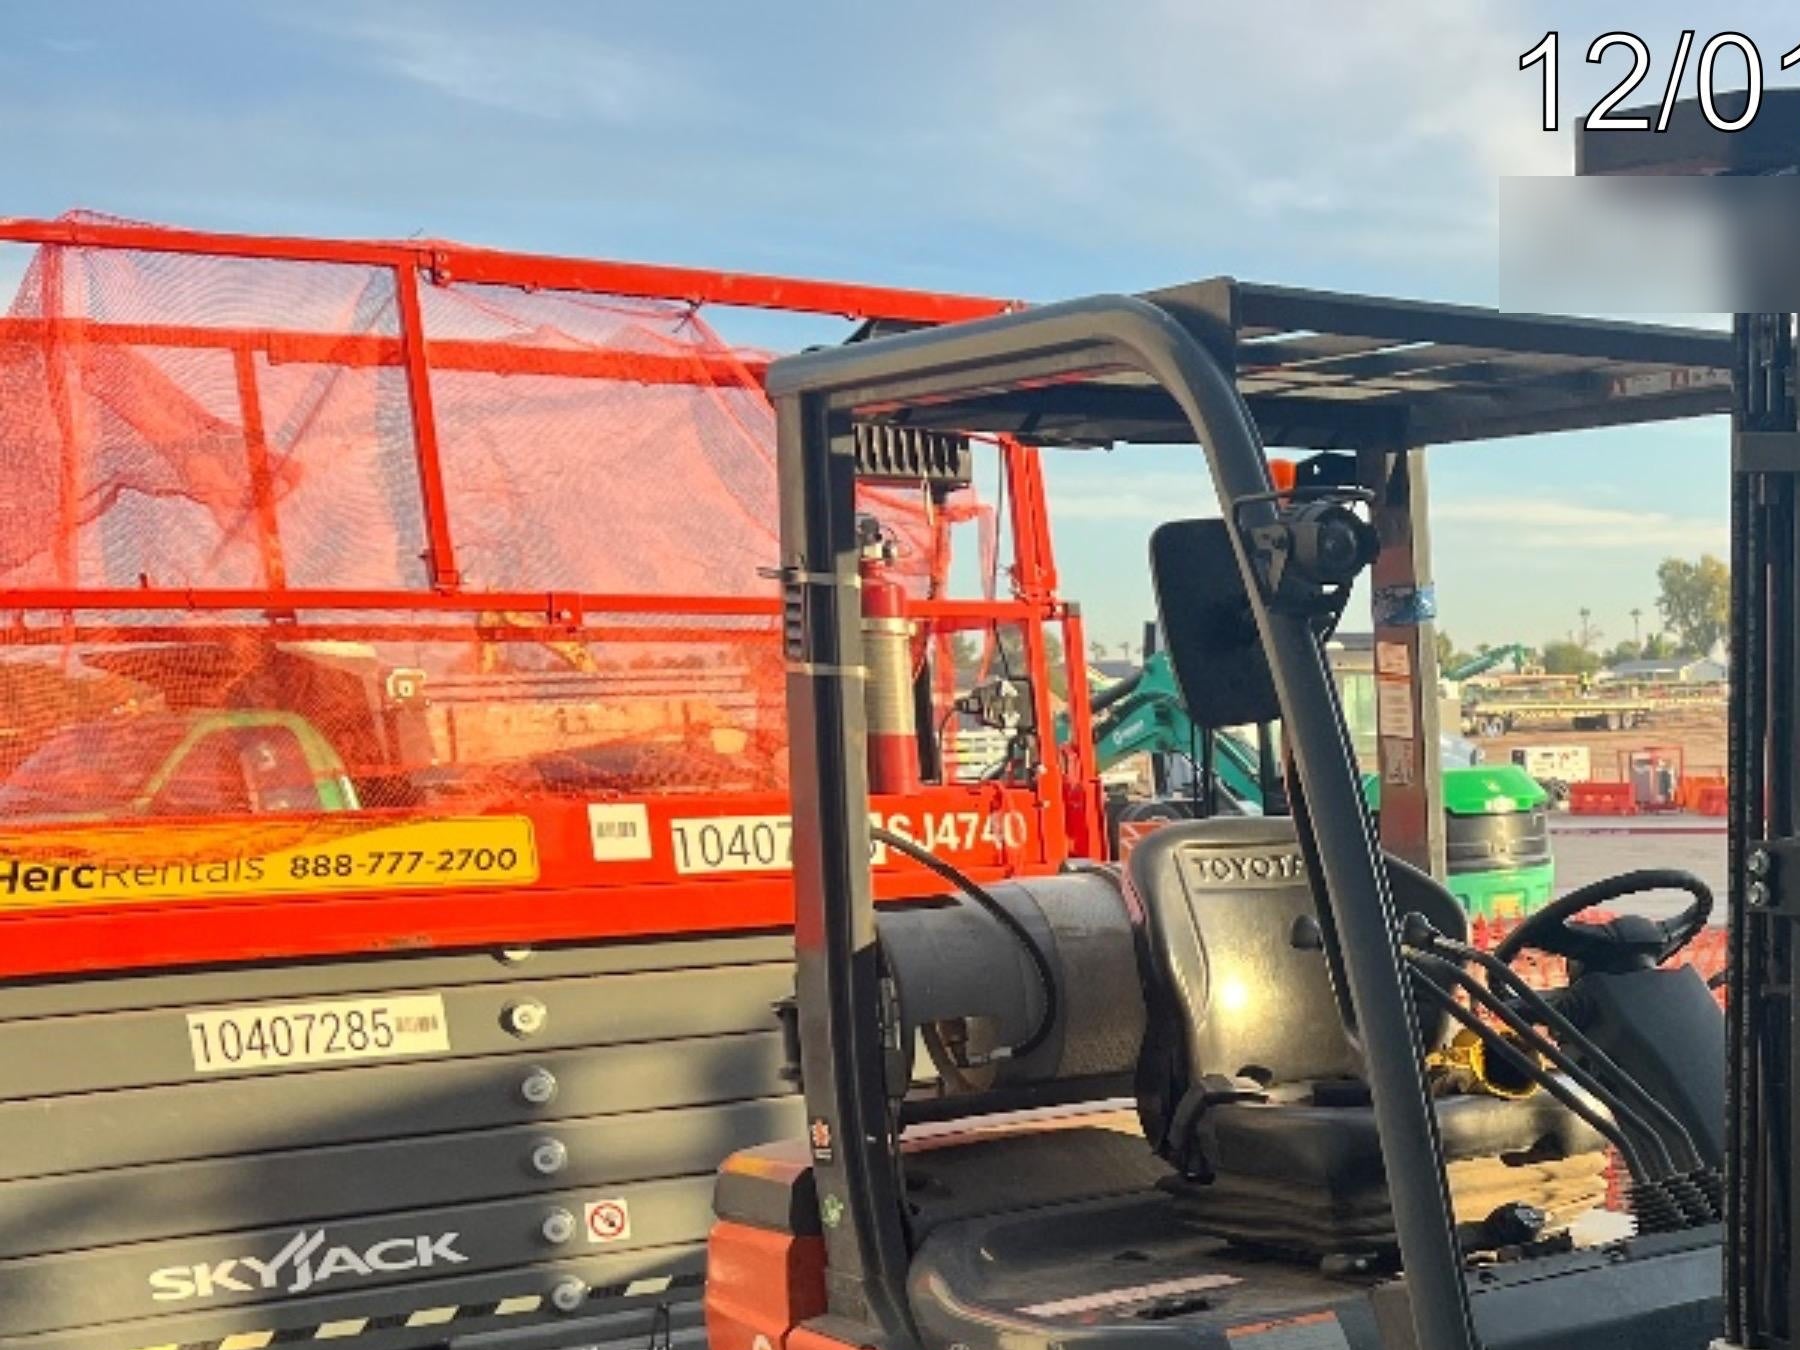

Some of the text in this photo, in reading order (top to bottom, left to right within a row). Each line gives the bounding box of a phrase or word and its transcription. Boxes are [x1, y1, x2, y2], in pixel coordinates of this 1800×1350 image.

[290, 848, 518, 878] 888-777-2700
[192, 1008, 393, 1063] 10407285
[149, 1229, 469, 1301] SKYJACK
